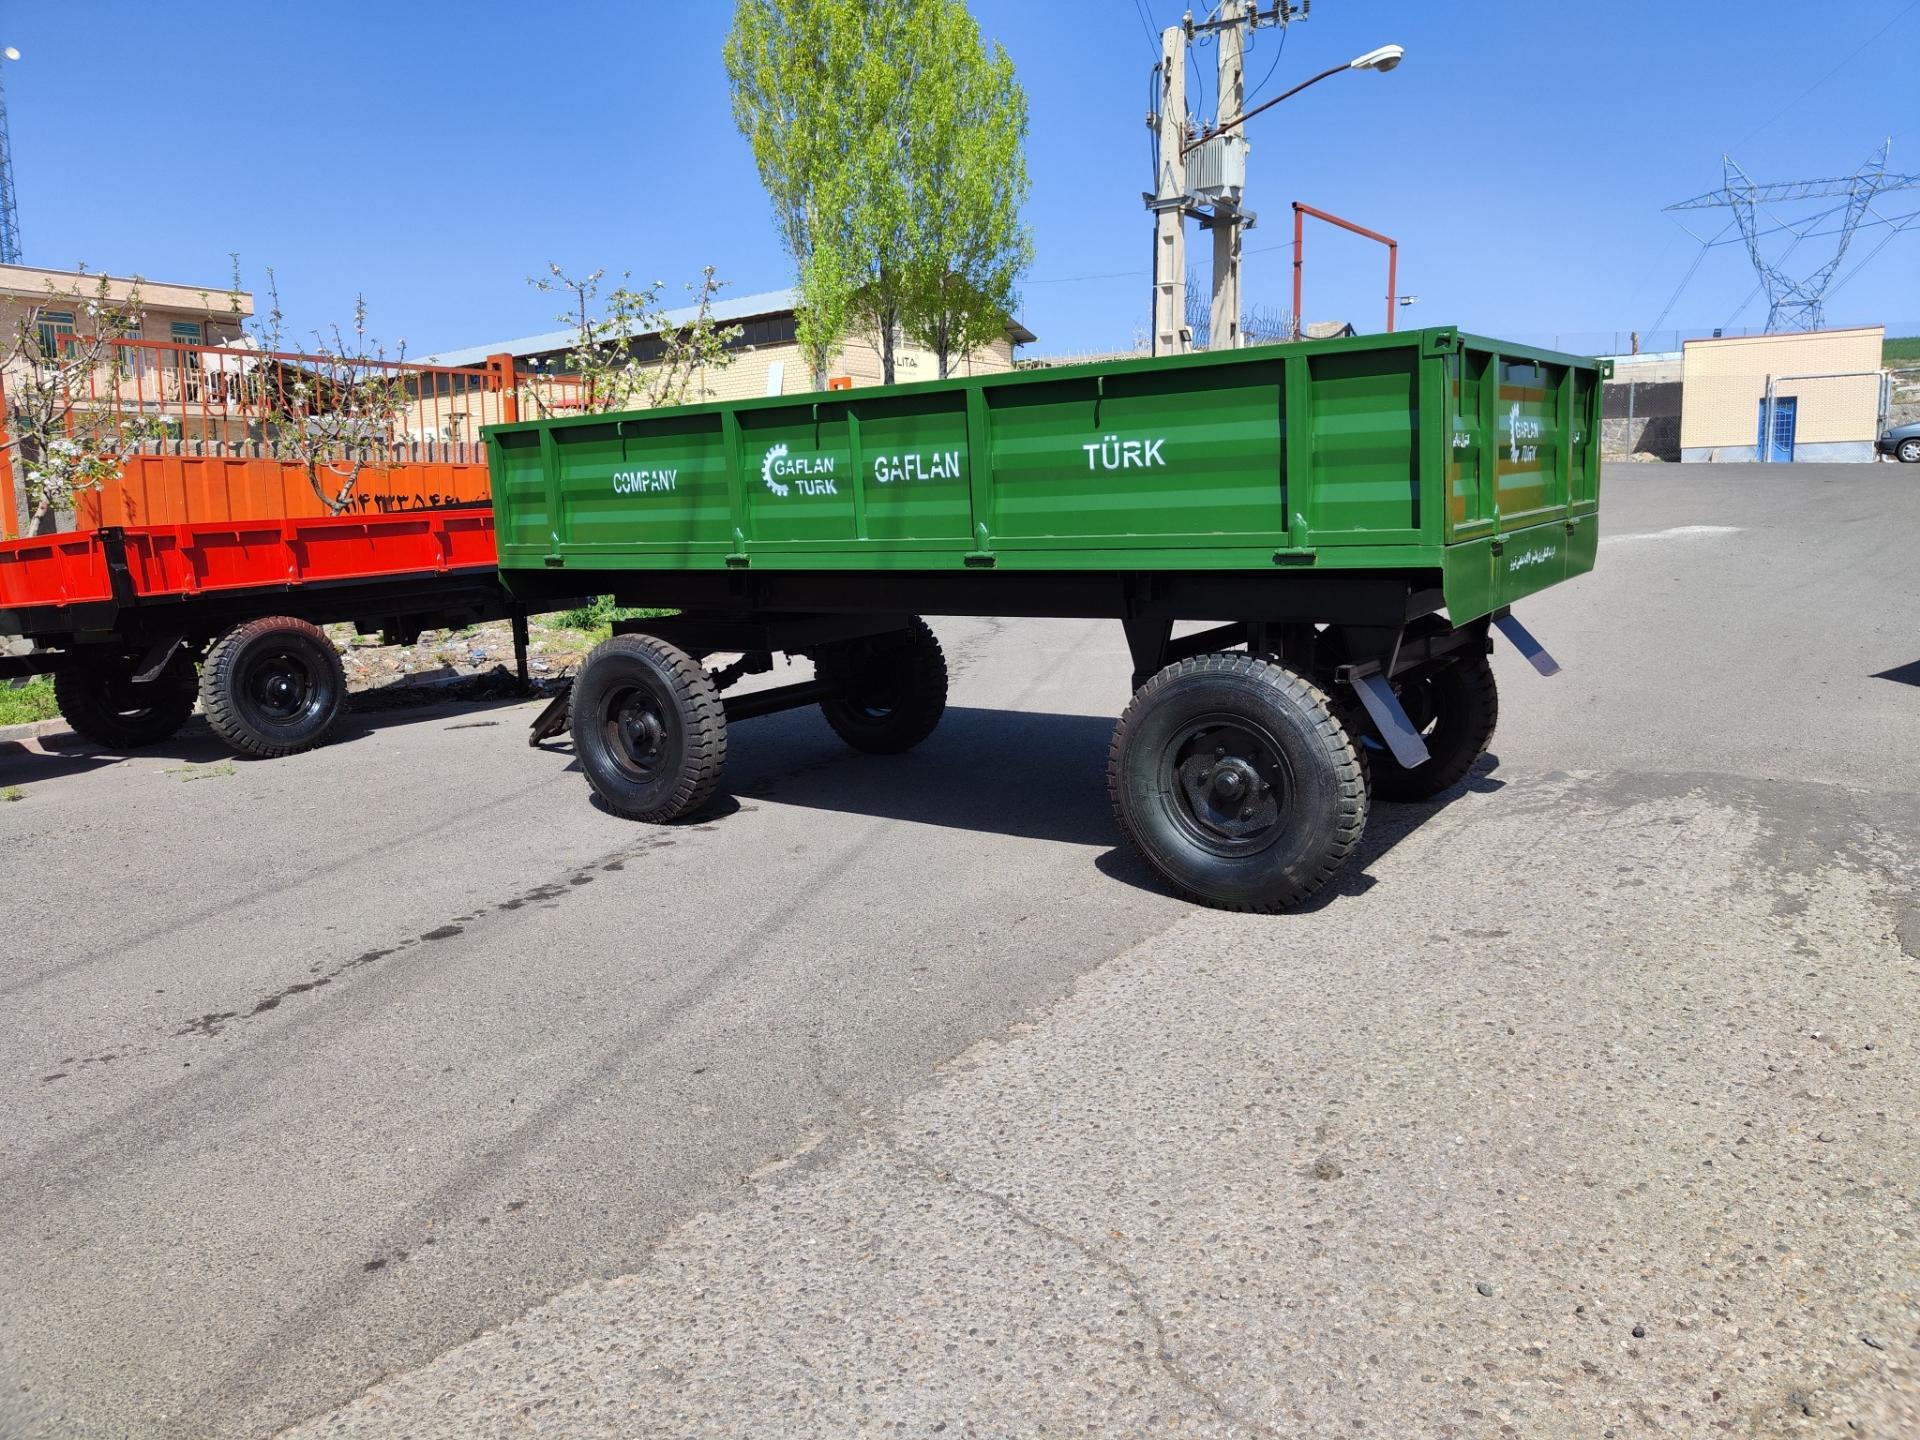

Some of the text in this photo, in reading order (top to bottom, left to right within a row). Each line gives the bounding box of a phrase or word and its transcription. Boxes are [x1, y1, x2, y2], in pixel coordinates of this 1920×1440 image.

[893, 355, 917, 368] LITA
[1083, 435, 1166, 470] TÜRK
[774, 457, 834, 476] GAFLAN
[874, 451, 960, 482] GAFLAN
[613, 469, 677, 494] COMPANY
[794, 479, 838, 495] TURK
